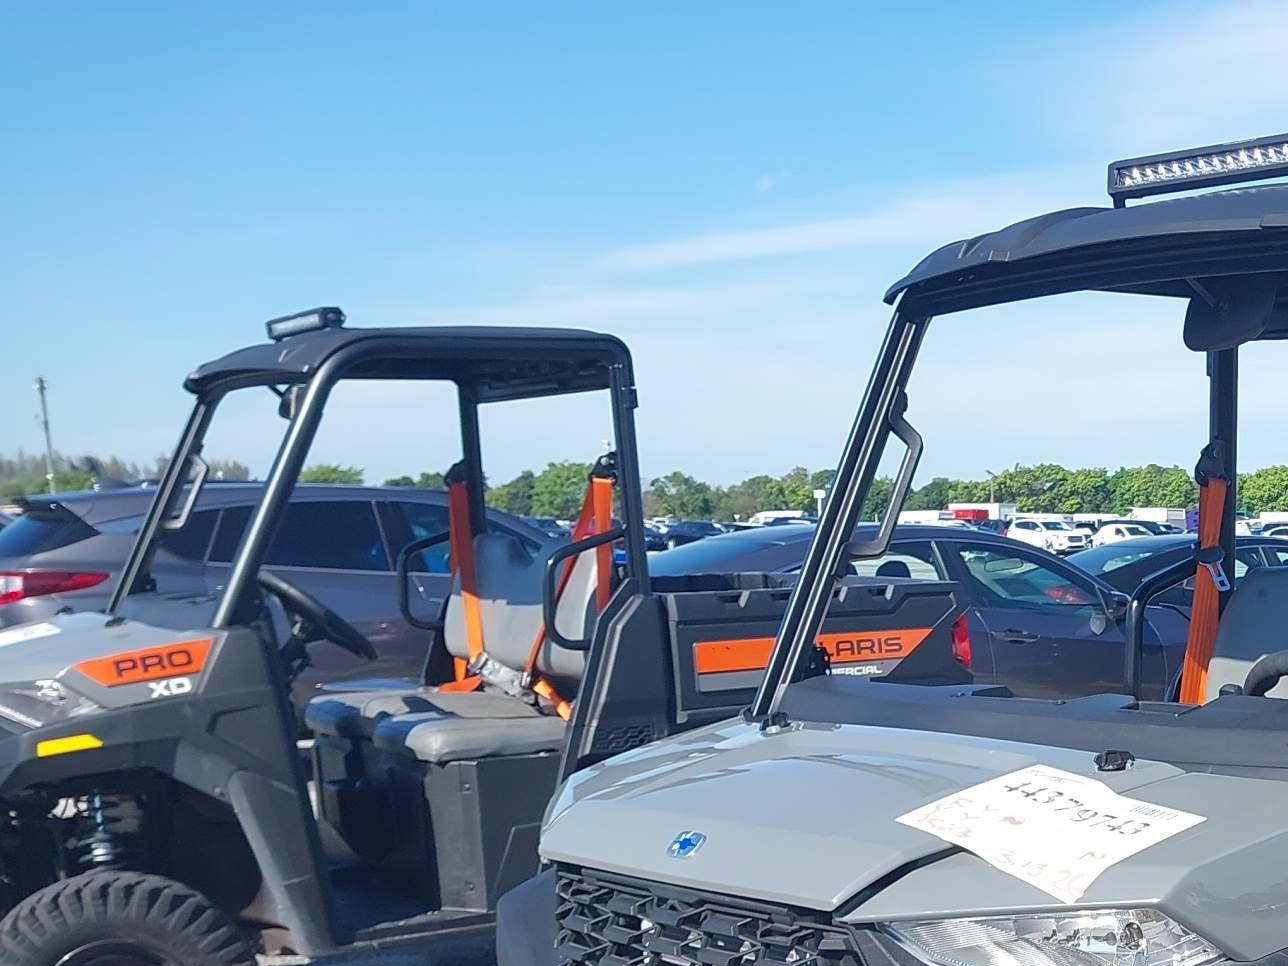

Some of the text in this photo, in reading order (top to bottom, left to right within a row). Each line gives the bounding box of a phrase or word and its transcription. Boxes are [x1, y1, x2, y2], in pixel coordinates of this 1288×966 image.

[114, 650, 193, 678] PRO
[148, 677, 192, 698] XD
[1003, 781, 1152, 836] 44379743
